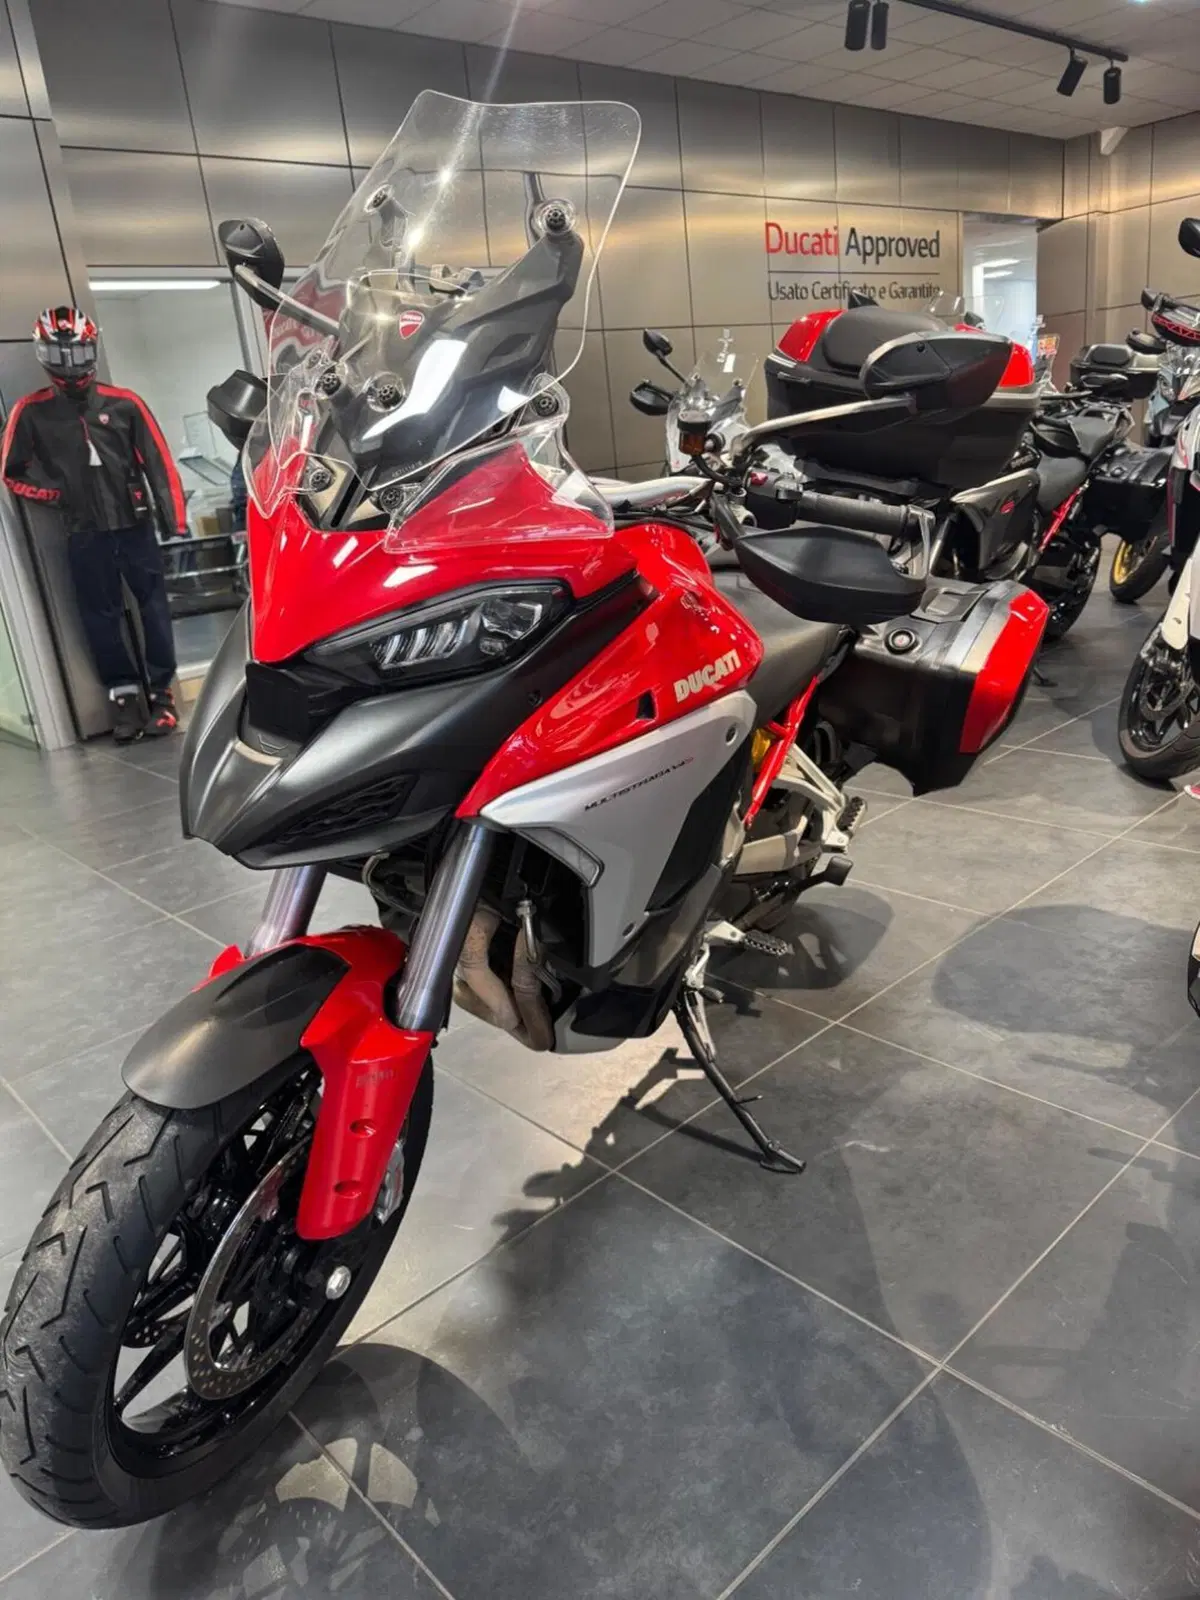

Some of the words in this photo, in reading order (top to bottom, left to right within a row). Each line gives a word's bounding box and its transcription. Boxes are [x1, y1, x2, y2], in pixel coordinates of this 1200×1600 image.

[765, 222, 838, 256] Ducati
[845, 227, 940, 265] Approved
[768, 281, 808, 300] Usato
[879, 286, 886, 299] e
[673, 648, 741, 703] DUCATI
